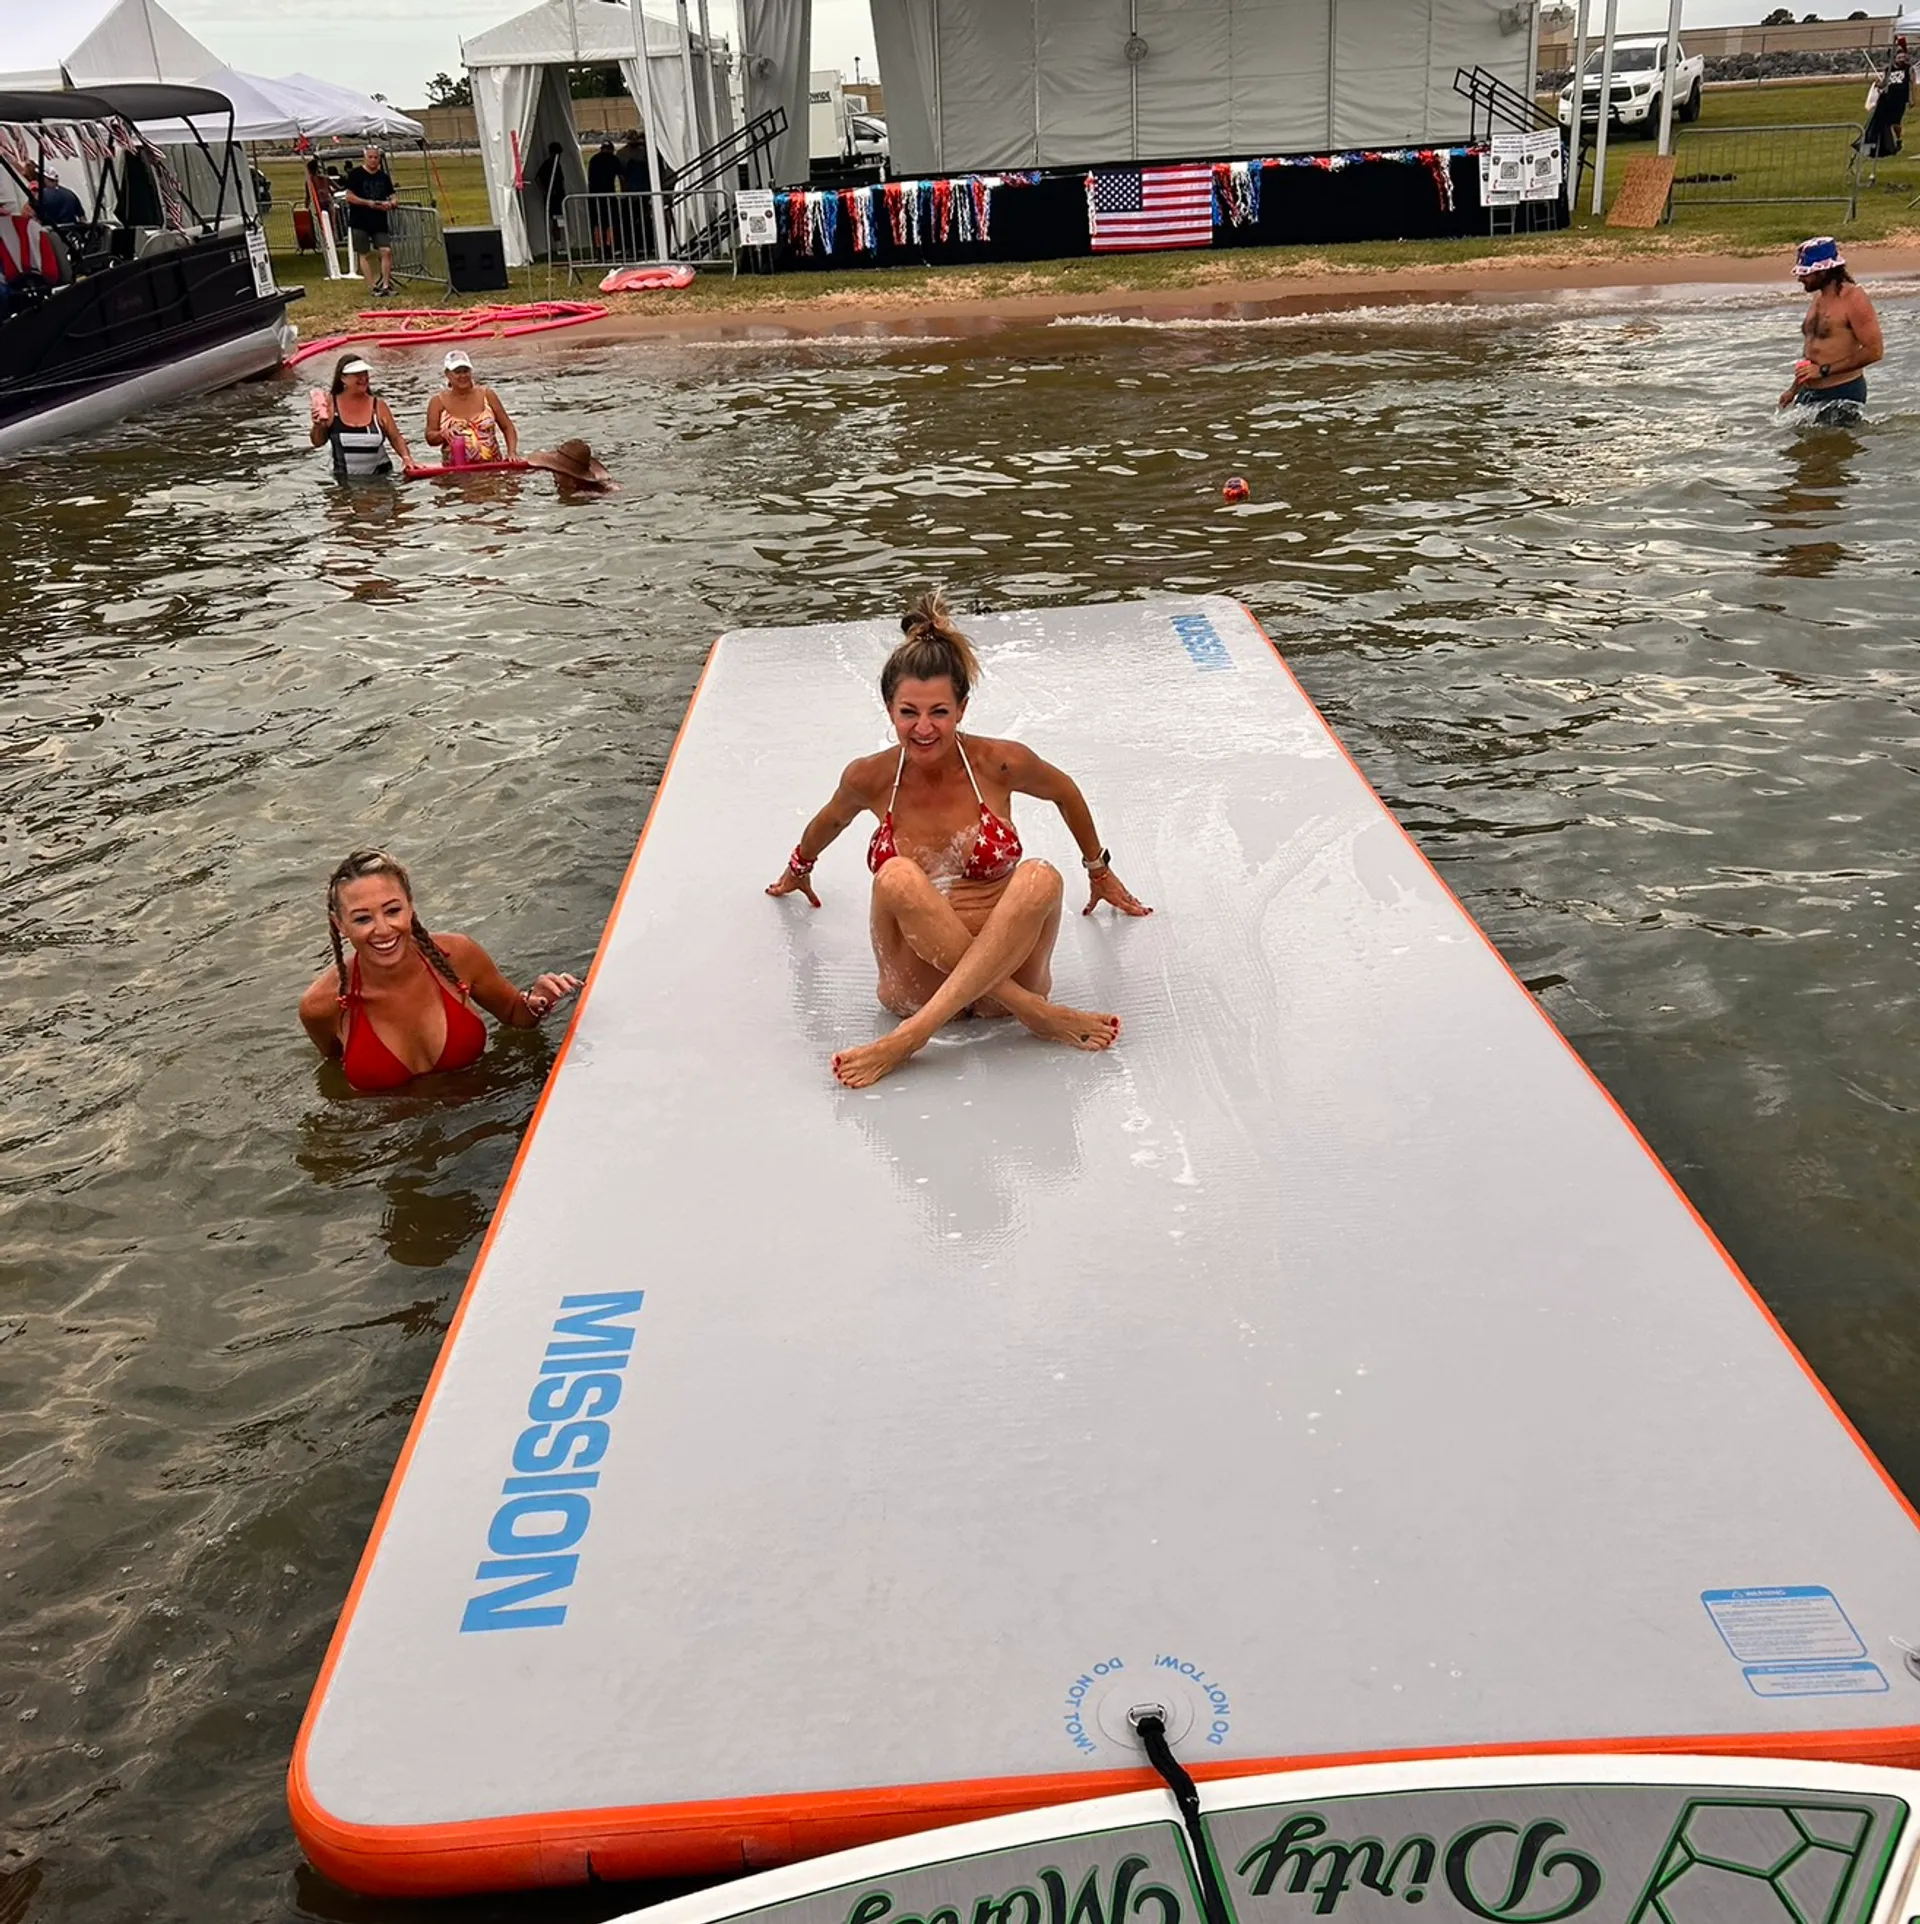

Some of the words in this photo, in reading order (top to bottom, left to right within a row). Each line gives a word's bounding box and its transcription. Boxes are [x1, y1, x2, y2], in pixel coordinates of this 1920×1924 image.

[1169, 613, 1237, 672] MISSION
[459, 1290, 645, 1634] MISSION
[1093, 1657, 1124, 1675] DO
[1154, 1654, 1205, 1682] TOW!
[1065, 1674, 1095, 1708] NOT
[1203, 1682, 1231, 1715] NOT
[1064, 1712, 1097, 1755] TOW!
[1206, 1720, 1230, 1745] DO
[1233, 1812, 1604, 1924] Dirty
